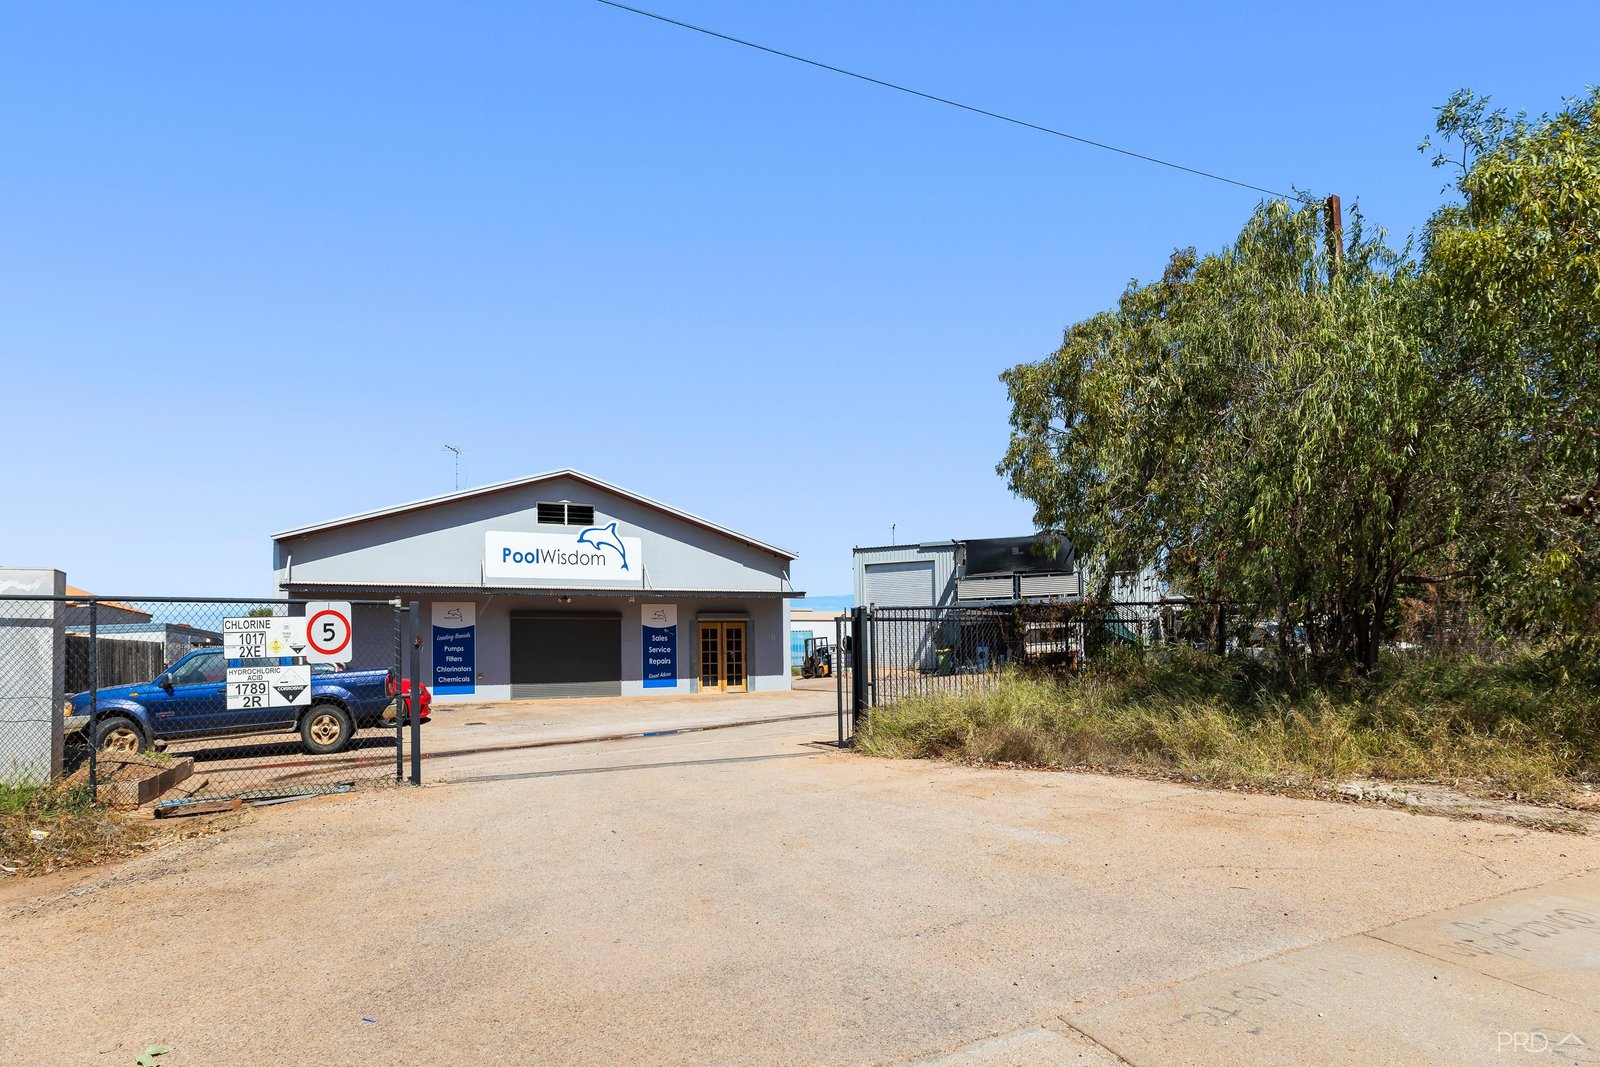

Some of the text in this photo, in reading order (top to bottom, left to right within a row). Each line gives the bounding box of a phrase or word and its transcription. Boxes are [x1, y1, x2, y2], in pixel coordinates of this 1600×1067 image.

[503, 548, 606, 566] PoolWisdom
[225, 619, 271, 630] CHLORINE
[323, 623, 336, 642] 5
[239, 633, 265, 645] 1017
[239, 645, 261, 658] 2XE
[235, 683, 266, 694] 1789
[243, 696, 262, 707] 2R
